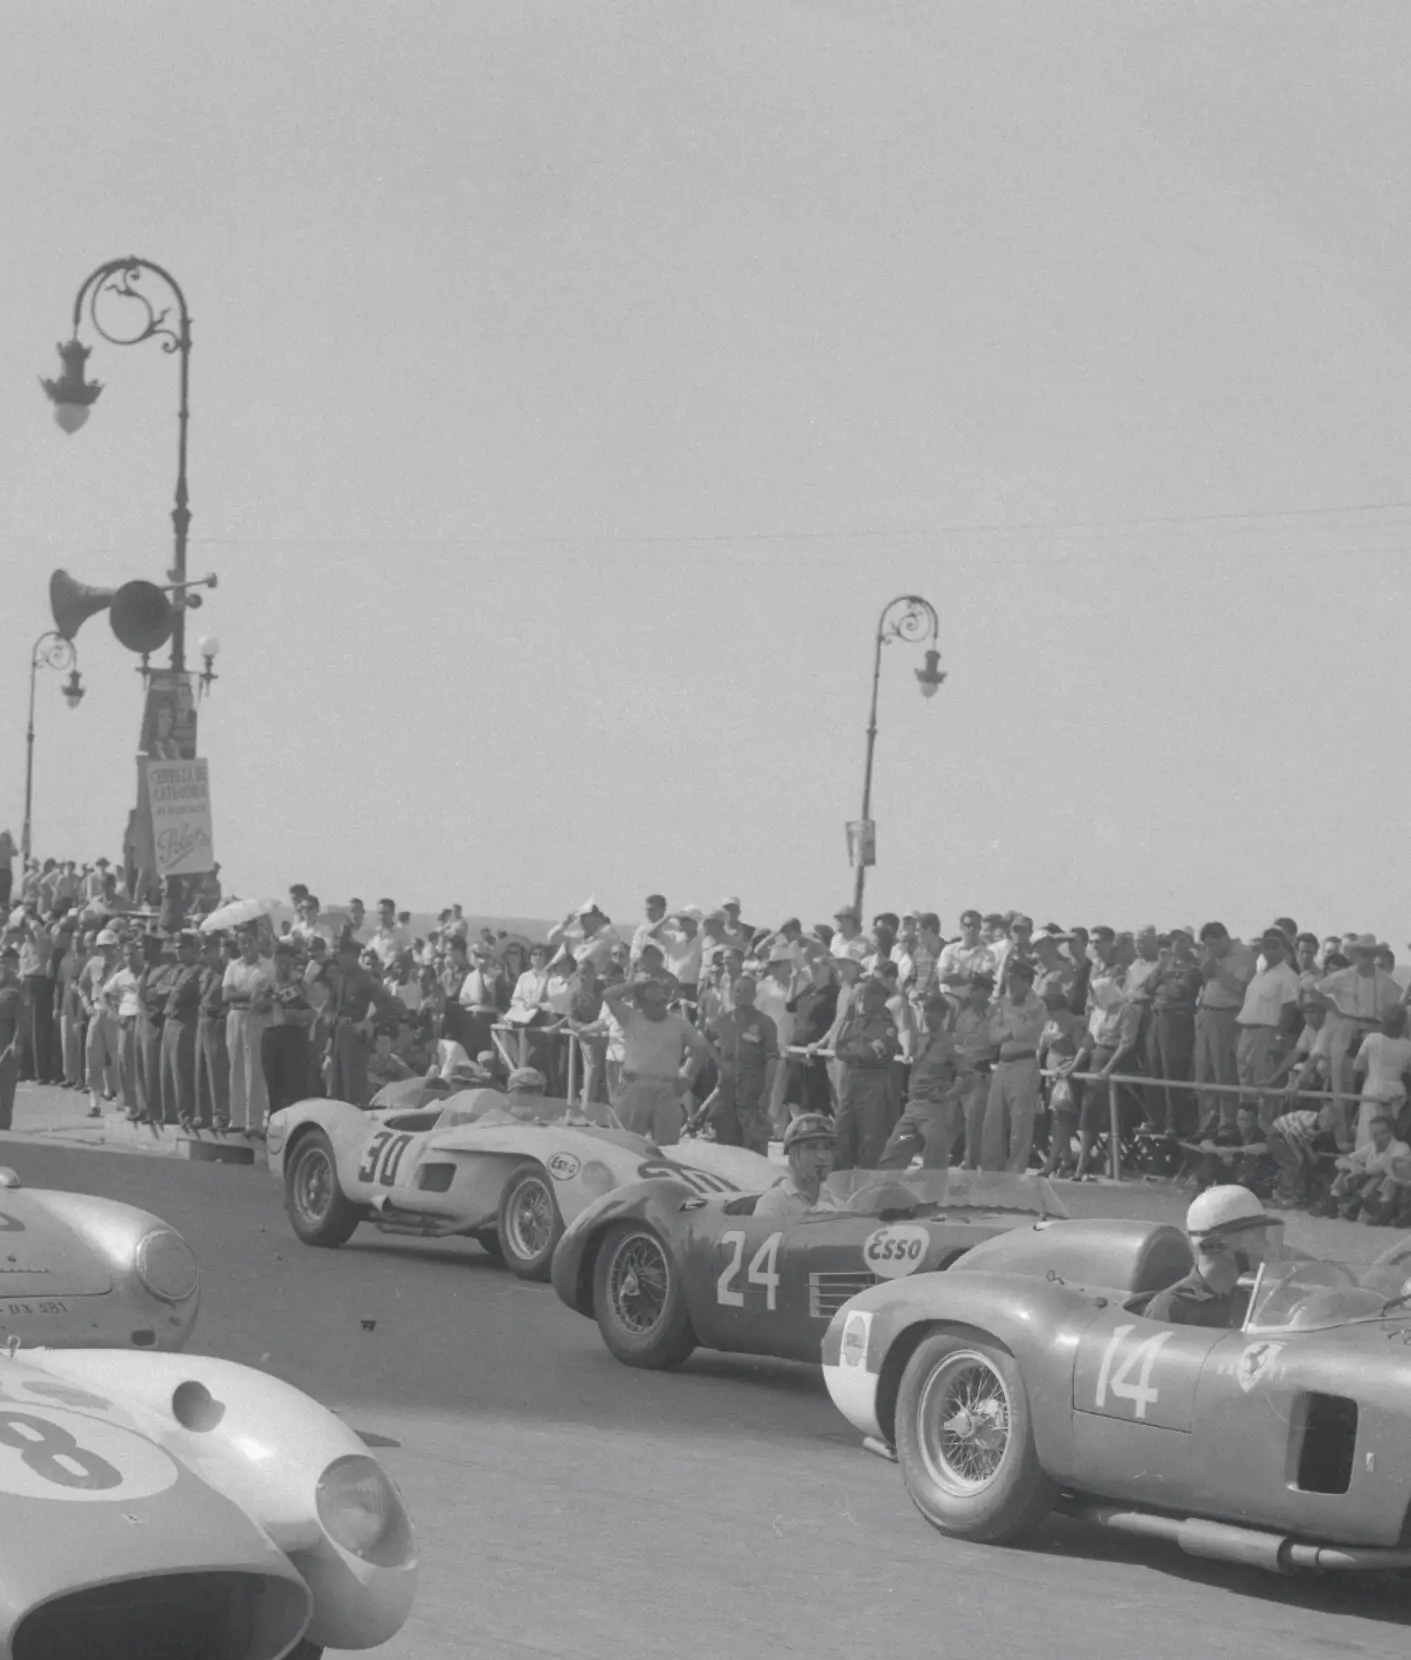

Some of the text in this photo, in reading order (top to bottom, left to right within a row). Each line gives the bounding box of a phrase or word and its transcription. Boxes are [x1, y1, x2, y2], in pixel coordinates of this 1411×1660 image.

[359, 1131, 414, 1187] 30
[717, 1229, 780, 1311] 24
[1095, 1323, 1175, 1419] 14
